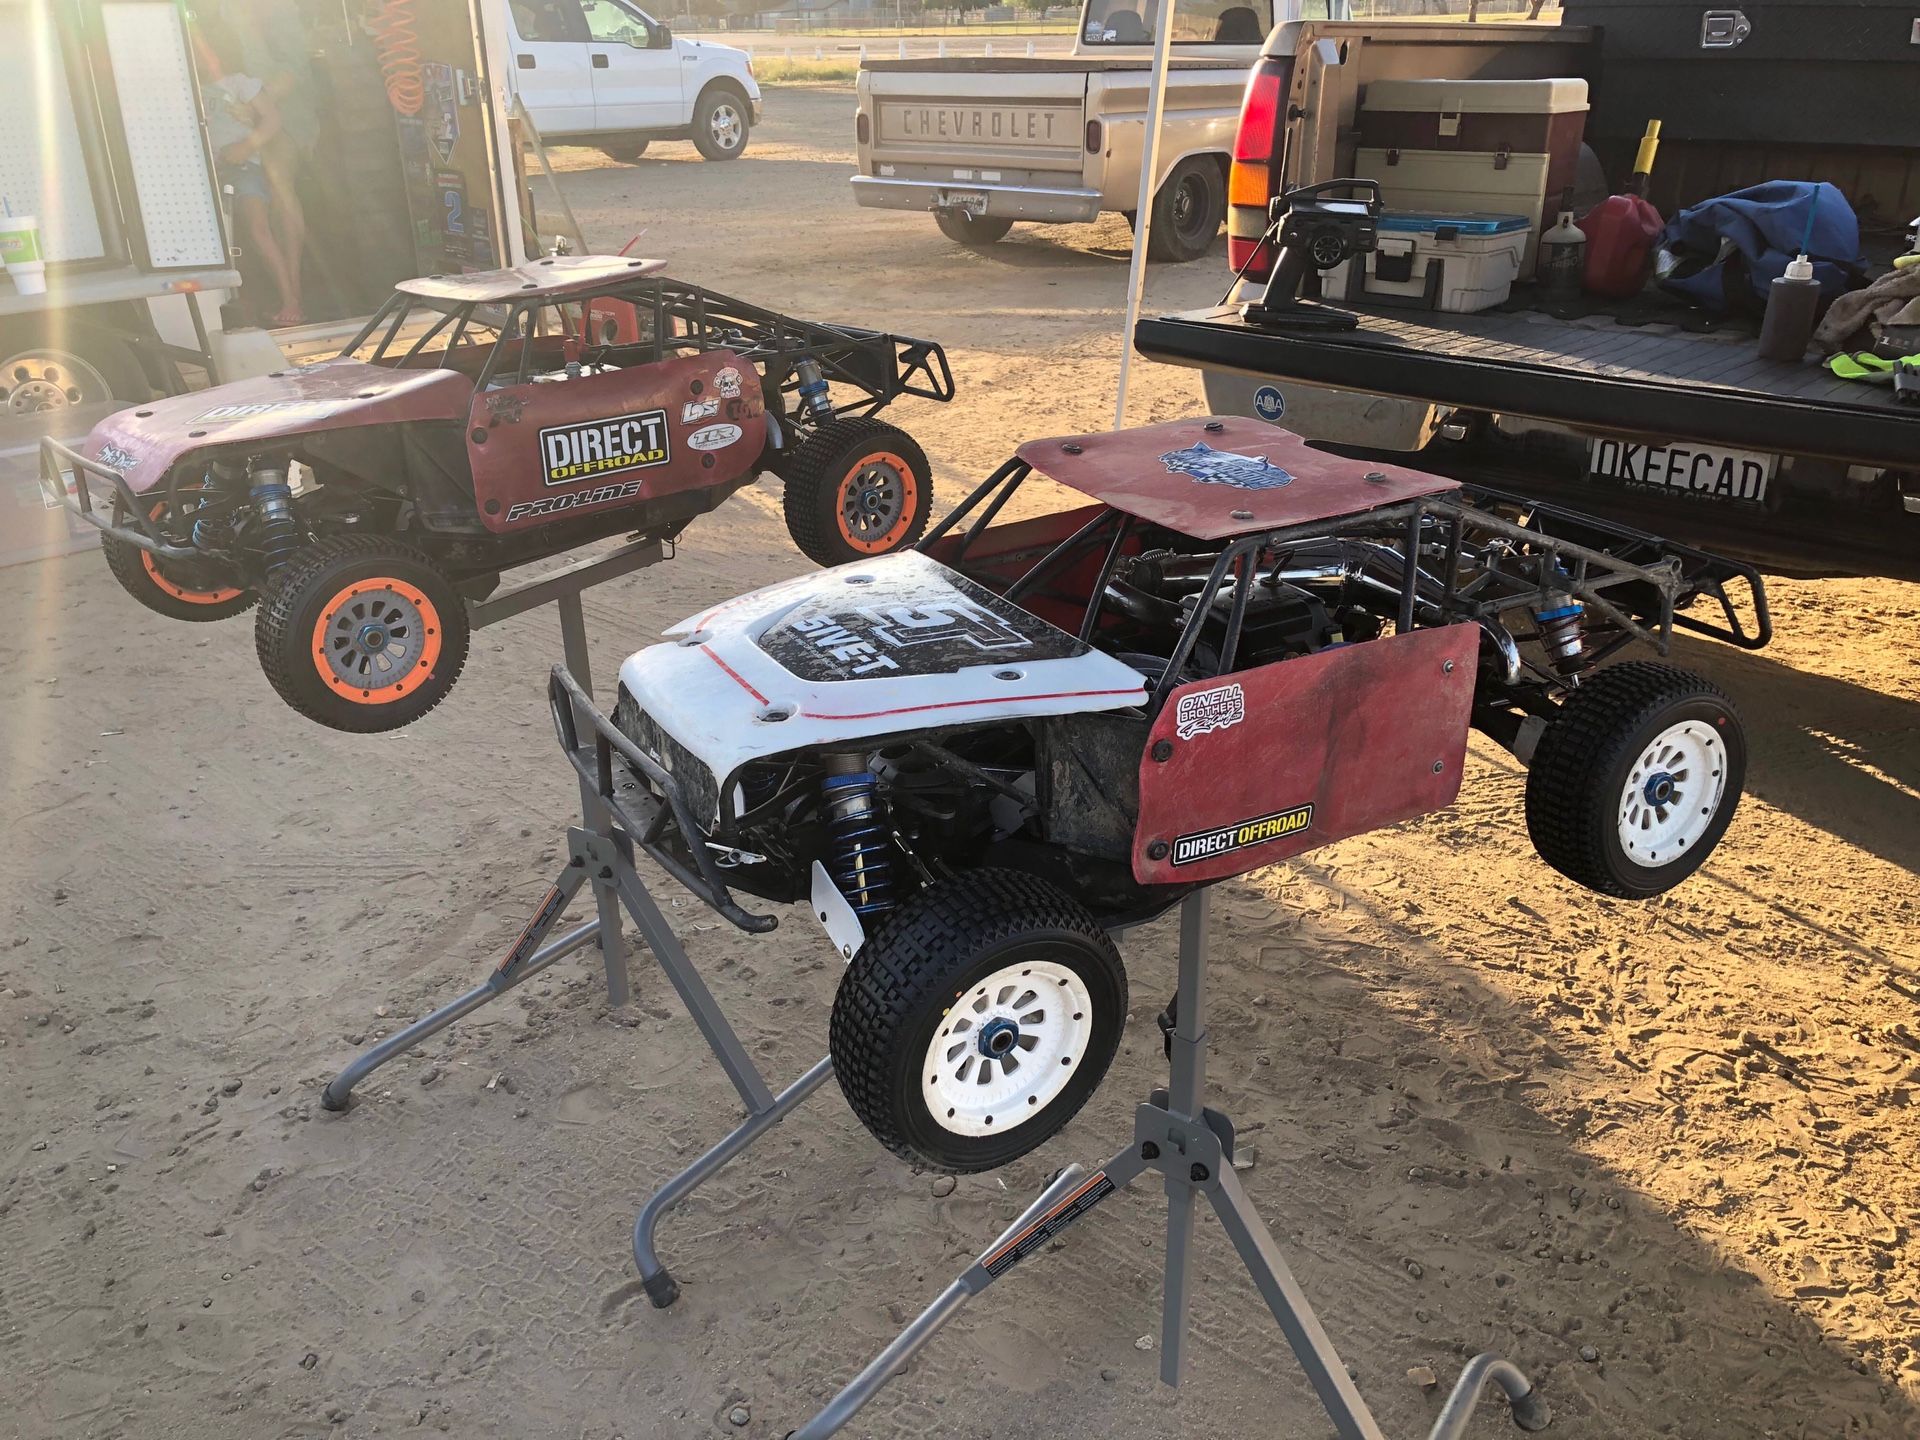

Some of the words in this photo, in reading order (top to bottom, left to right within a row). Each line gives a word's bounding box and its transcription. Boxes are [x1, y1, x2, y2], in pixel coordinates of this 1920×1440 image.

[903, 110, 1055, 139] CHEVROLET
[444, 191, 464, 233] 2
[547, 417, 661, 468] DIRECT
[551, 449, 664, 479] OFFROAD
[1180, 686, 1242, 712] O'NEILL
[1181, 698, 1242, 722] BROTHERS
[1179, 829, 1238, 859] DIRECT
[1238, 811, 1308, 844] OFFROAD
